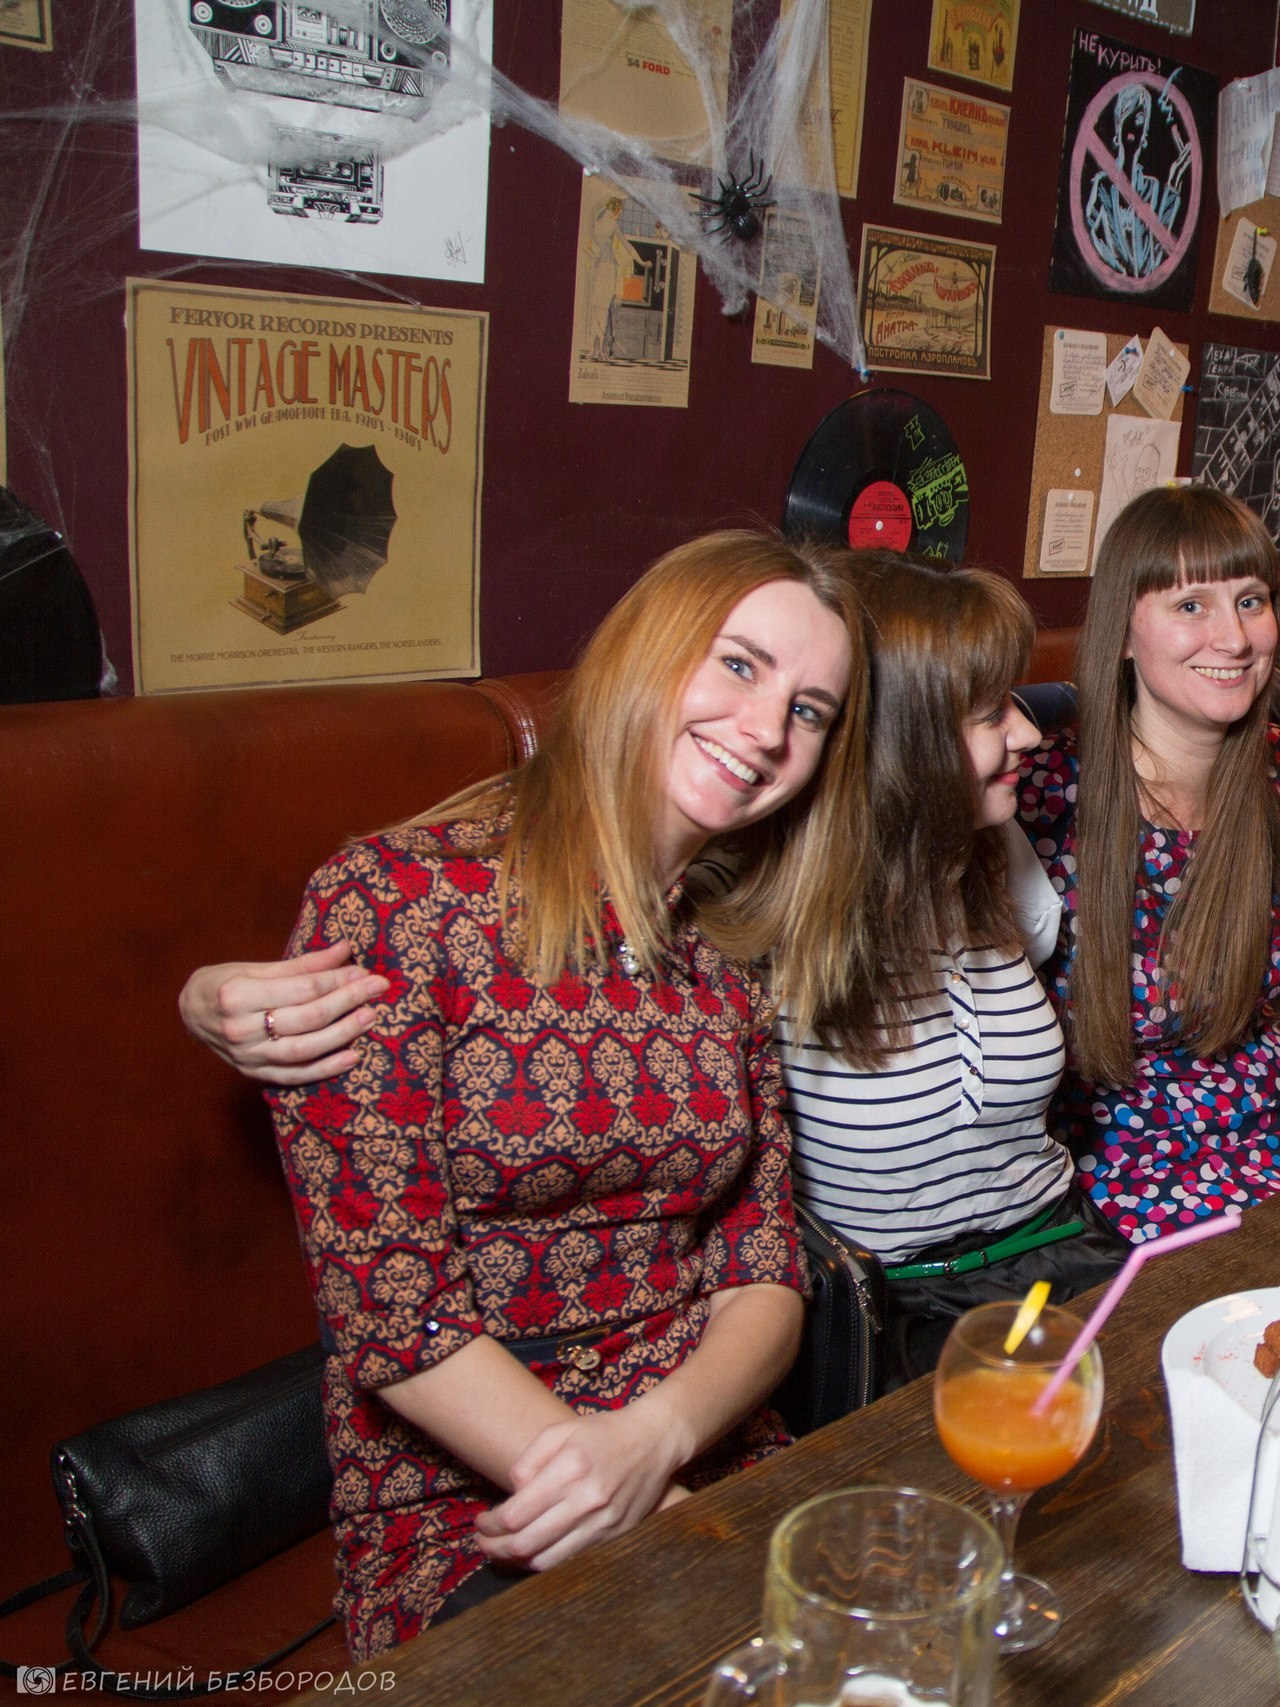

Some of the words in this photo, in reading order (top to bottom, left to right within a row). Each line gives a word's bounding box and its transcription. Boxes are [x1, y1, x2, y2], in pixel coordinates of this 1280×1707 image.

[642, 60, 670, 75] FORD
[1079, 30, 1100, 53] НЕ
[1097, 44, 1162, 74] КУРИТЬ!
[933, 140, 978, 162] KLEIN
[260, 315, 356, 339] RECORDS
[360, 324, 454, 346] PRESENTS
[166, 337, 321, 445] VINTAGE
[329, 343, 452, 455] MASTERS
[205, 426, 231, 446] POST
[260, 406, 327, 425] GRAMOPHONE
[170, 654, 185, 662] THE
